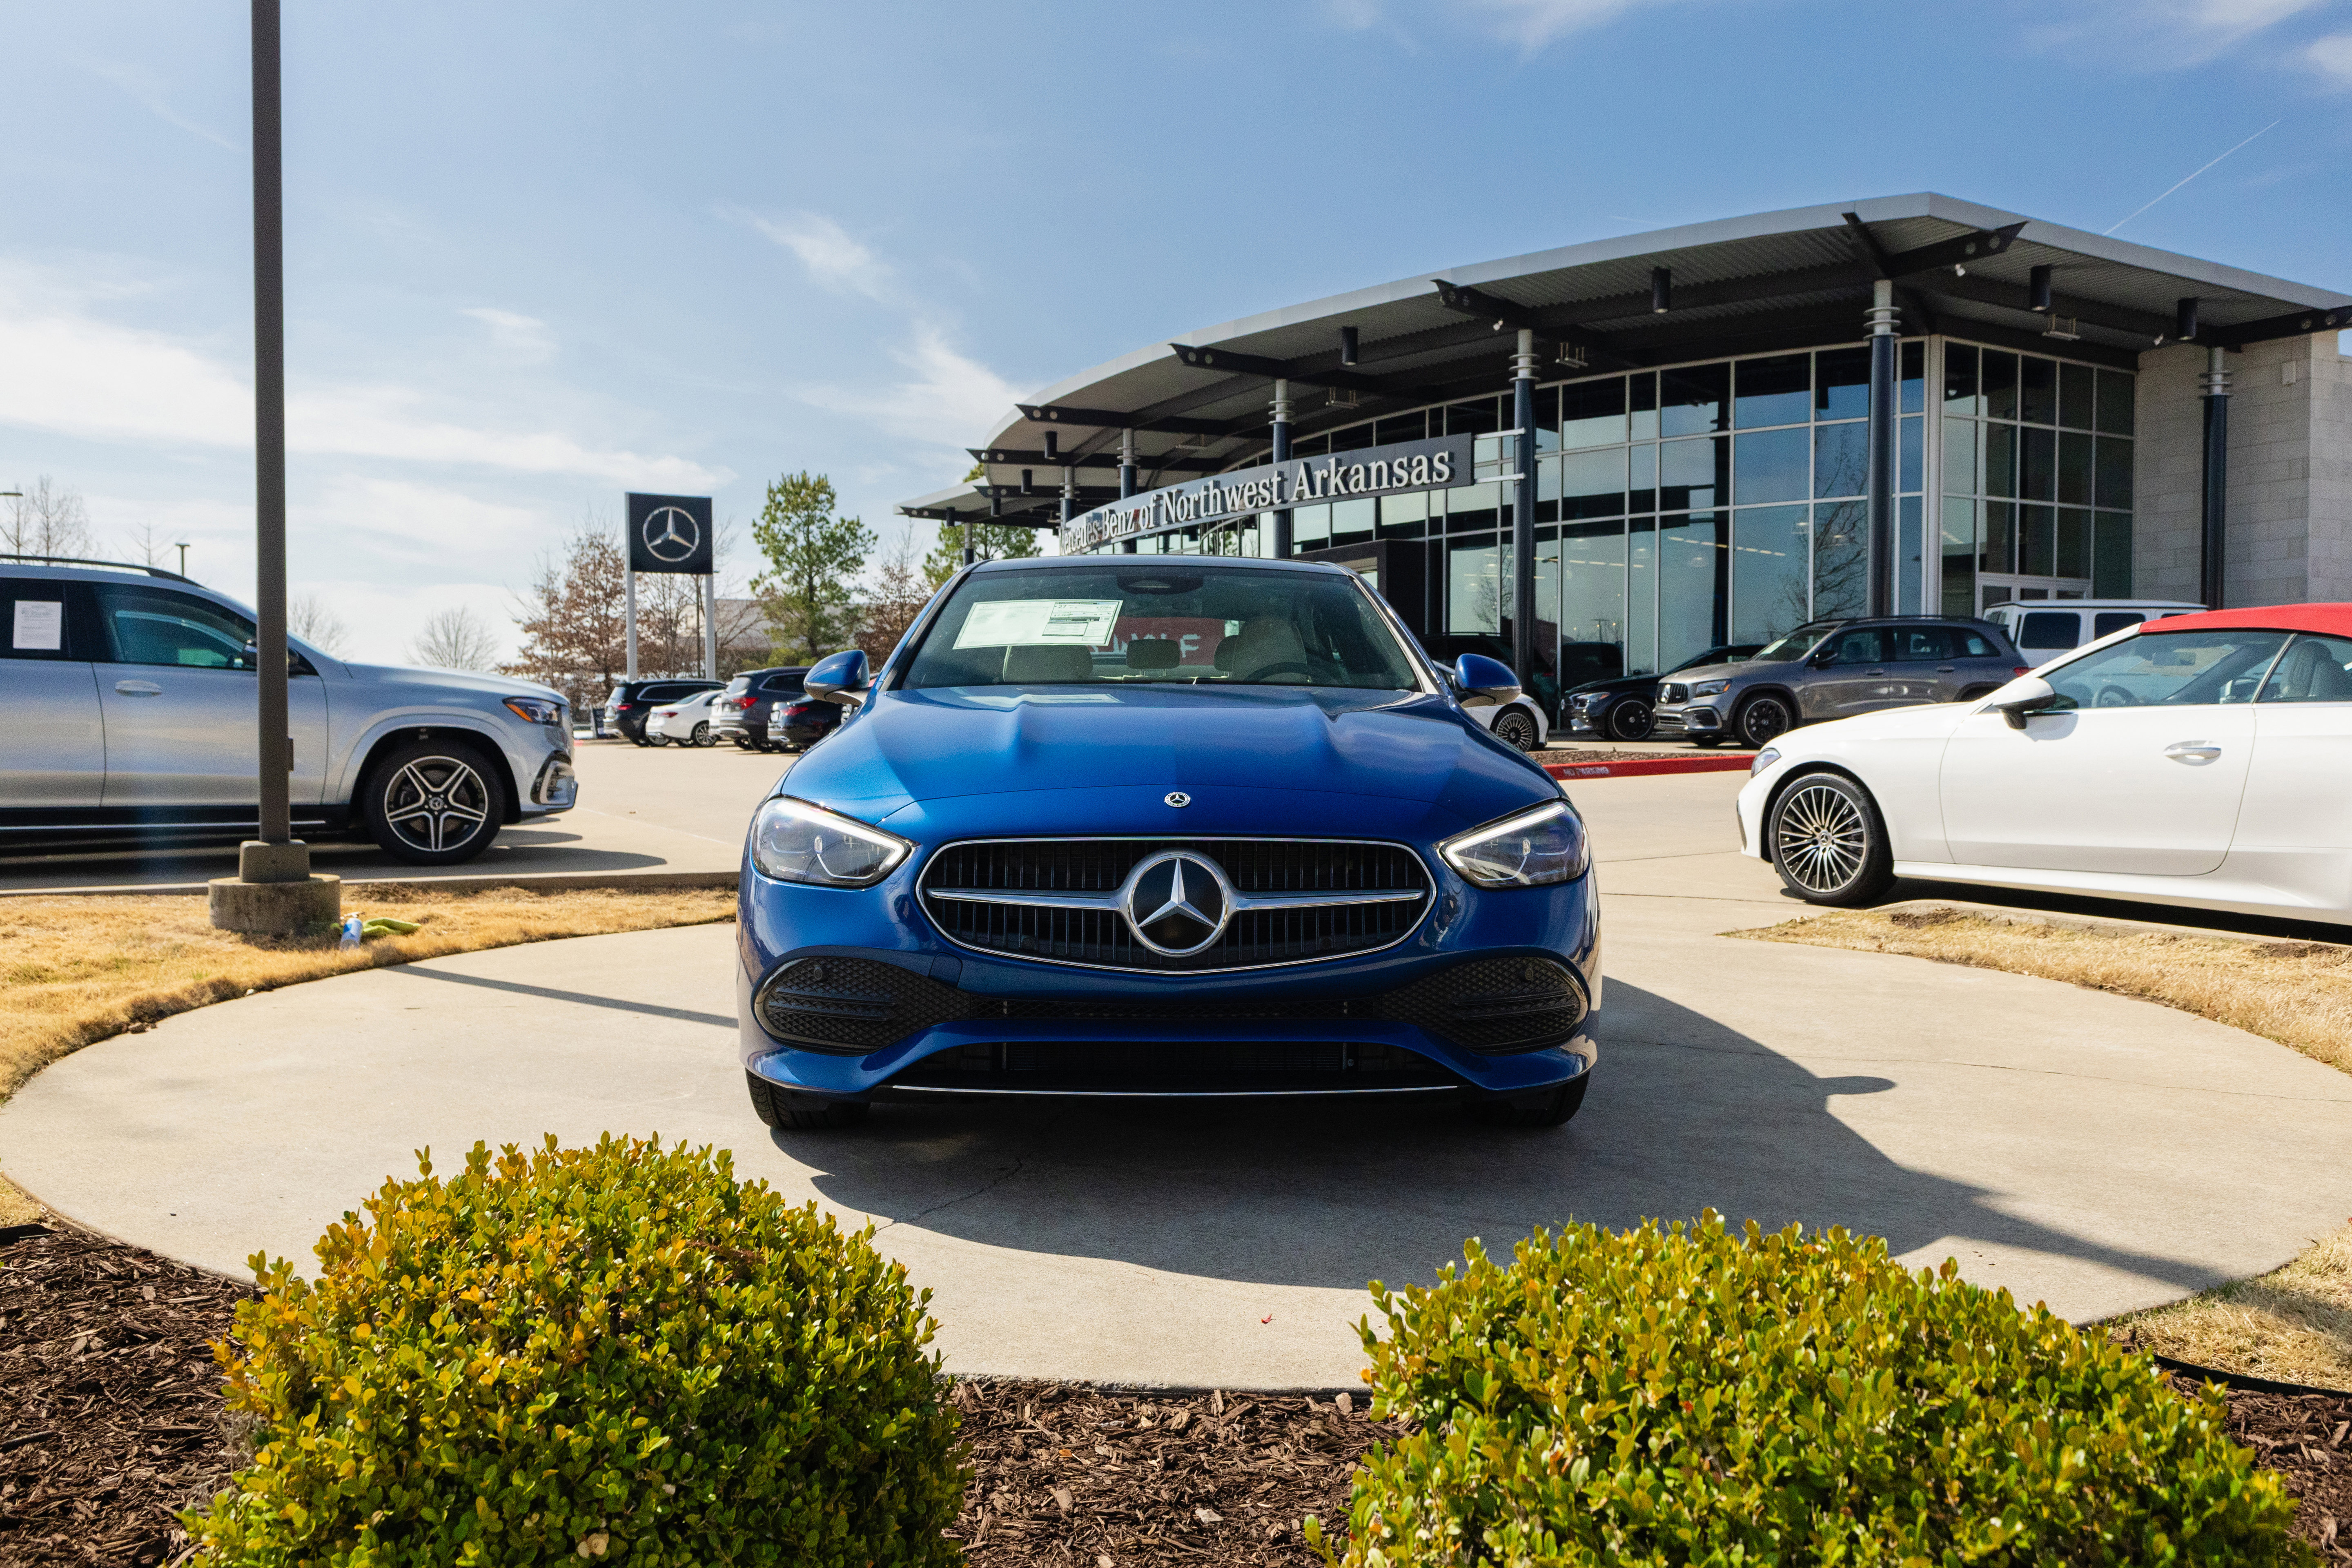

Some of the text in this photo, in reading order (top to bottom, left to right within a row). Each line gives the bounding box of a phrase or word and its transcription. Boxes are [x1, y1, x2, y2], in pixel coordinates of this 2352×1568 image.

[1138, 493, 1157, 530] of
[1162, 470, 1282, 524] Northwest
[1290, 450, 1450, 502] Arkansas
[1576, 766, 1609, 775] PARKING
